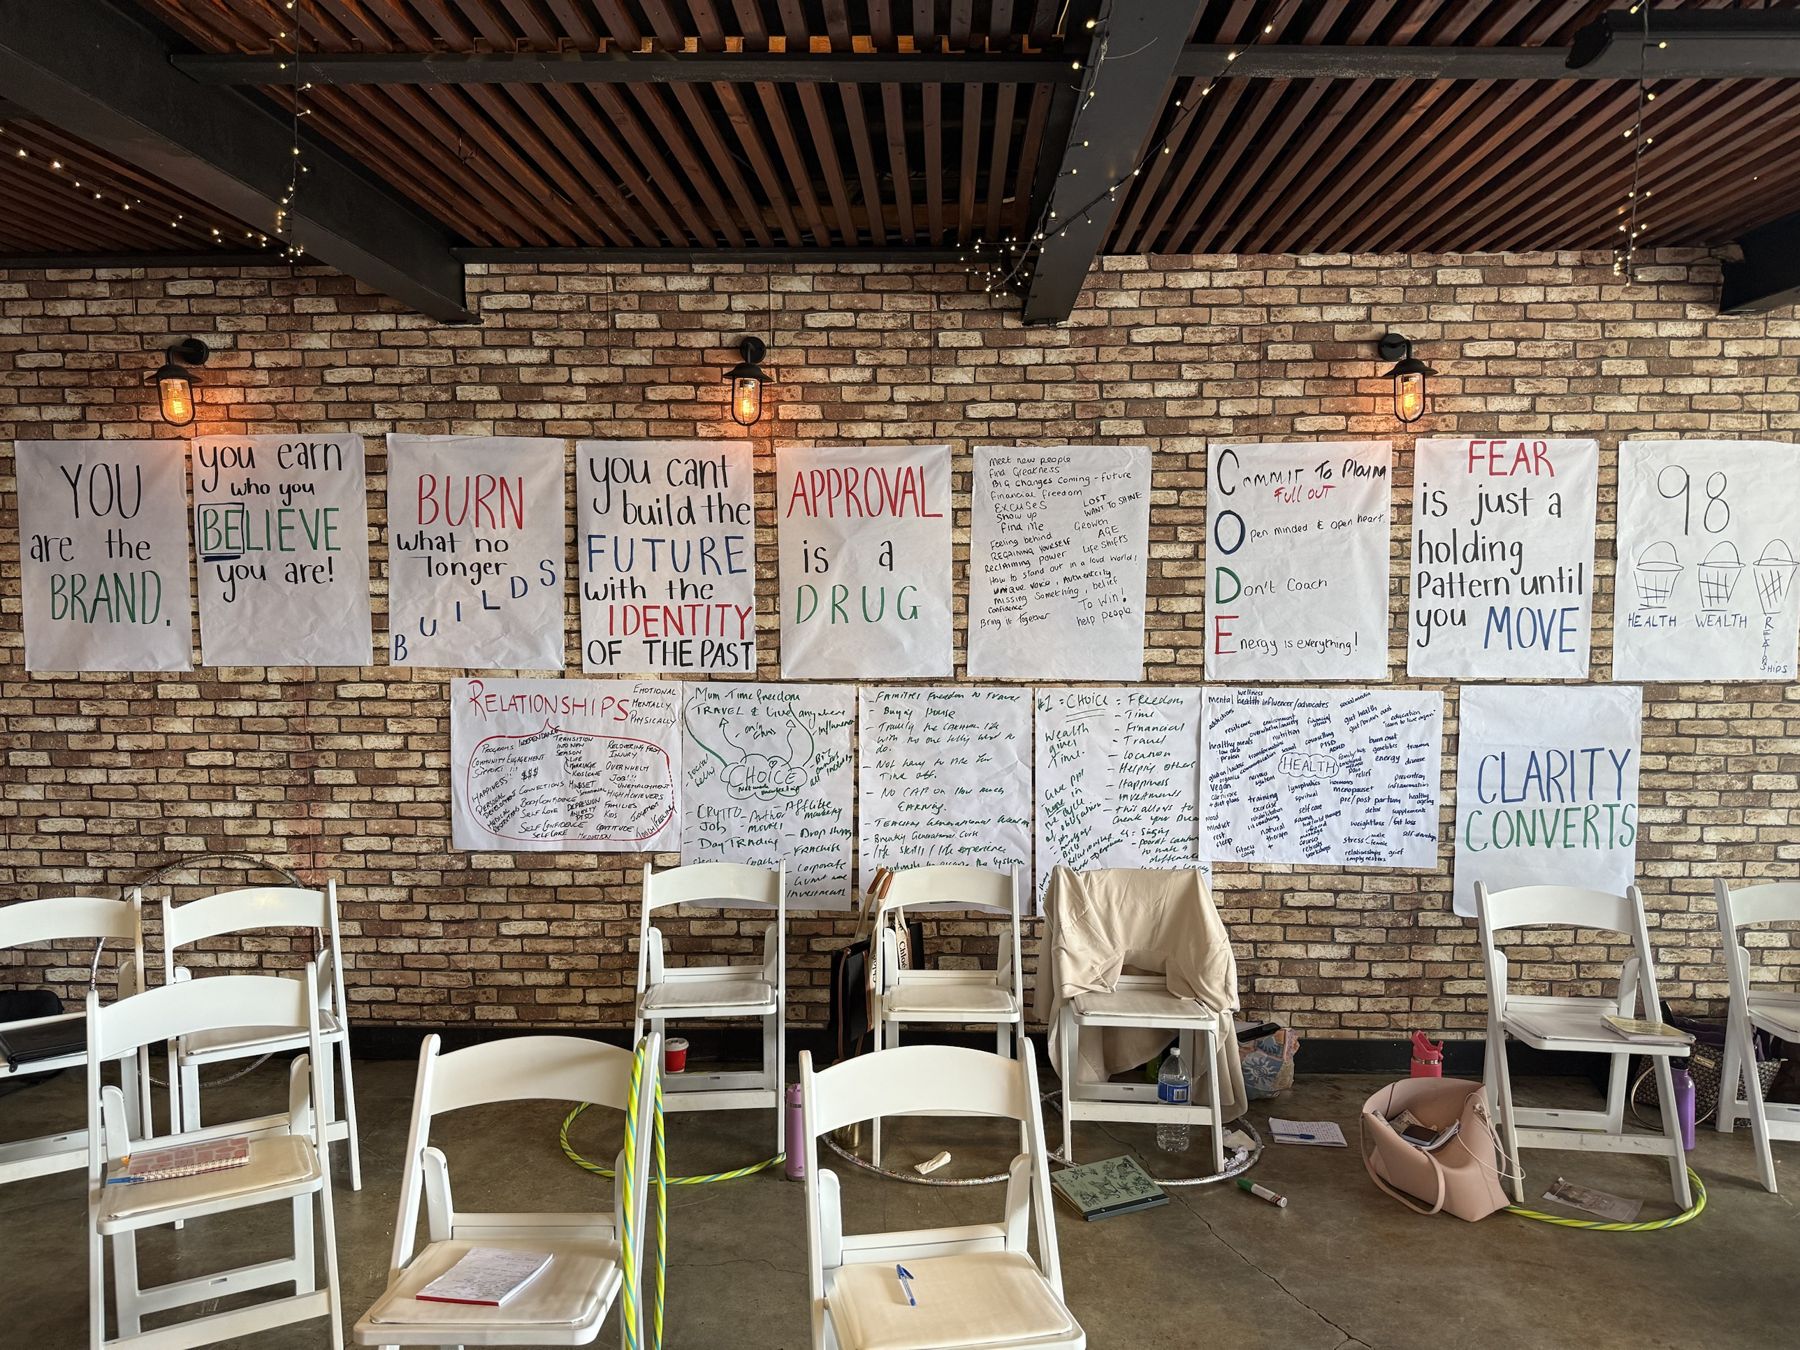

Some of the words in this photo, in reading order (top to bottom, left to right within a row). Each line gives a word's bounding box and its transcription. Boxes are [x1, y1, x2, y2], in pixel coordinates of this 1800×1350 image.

[200, 444, 254, 492] you
[277, 442, 342, 471] earn
[1468, 440, 1555, 477] FEAR
[60, 463, 141, 518] YOU
[231, 478, 271, 496] who
[279, 483, 315, 505] you
[418, 473, 523, 530] BURN
[590, 456, 650, 514] you
[667, 455, 732, 489] cant
[786, 465, 943, 518] APPROVAL
[1083, 494, 1107, 507] LOST
[1657, 464, 1730, 535] 98
[623, 489, 696, 526] build
[702, 492, 751, 524] the
[1421, 483, 1447, 519] is
[1470, 483, 1533, 526] just
[1548, 489, 1562, 519] a
[30, 532, 73, 562] are
[106, 529, 150, 560] the
[203, 507, 341, 552] BELIEVE
[476, 536, 508, 553] no
[1098, 525, 1119, 538] AGE
[588, 536, 748, 574] FUTURE
[804, 540, 829, 573] is
[879, 540, 893, 571] a
[1418, 531, 1523, 573] holding
[51, 571, 171, 626] BRAND.
[217, 564, 266, 602] you
[285, 557, 334, 584] are!
[584, 577, 645, 601] with
[665, 578, 714, 601] the
[1521, 563, 1583, 596] until
[609, 604, 753, 639] IDENTITY
[796, 584, 921, 625] DRUG
[1628, 612, 1677, 627] HEALTH
[1695, 614, 1747, 628] WEALTH
[1415, 609, 1466, 648] you
[1484, 607, 1580, 654] MOVE
[587, 640, 621, 667] OF
[643, 640, 694, 668] THE
[700, 640, 754, 671] PAST
[1478, 748, 1631, 804] CLARITY
[1465, 804, 1636, 851] CONVERTS
